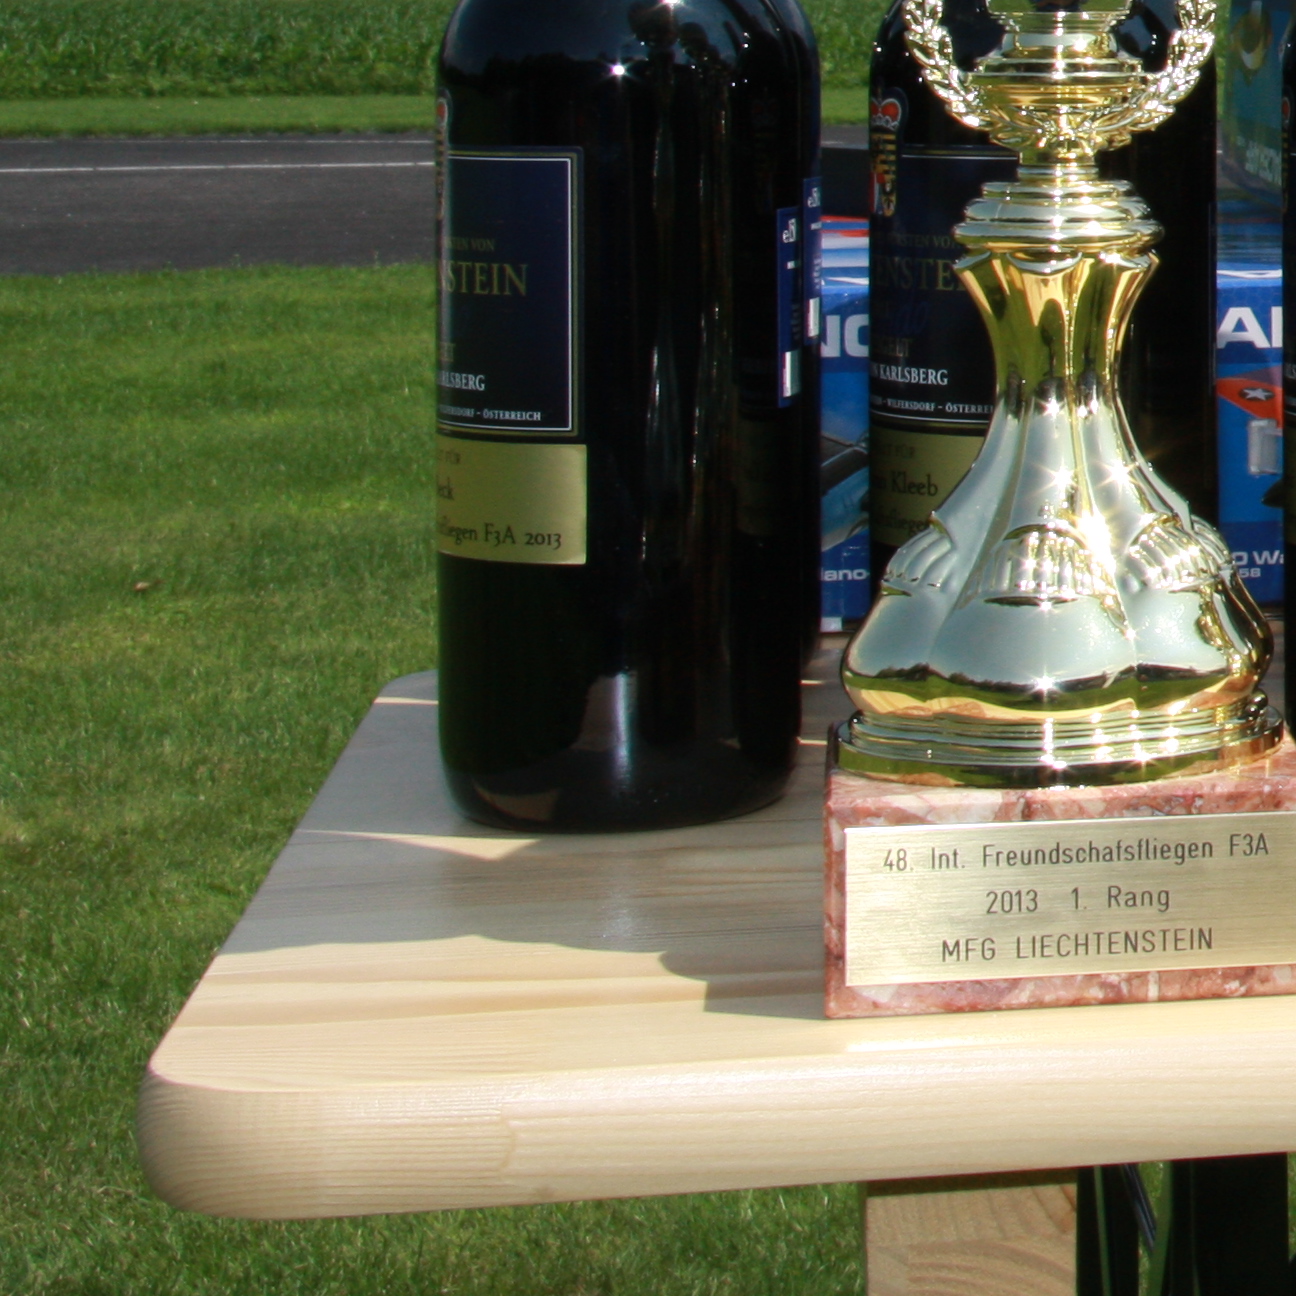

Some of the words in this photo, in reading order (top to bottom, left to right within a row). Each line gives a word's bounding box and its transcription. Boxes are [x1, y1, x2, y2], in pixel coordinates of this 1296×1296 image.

[1217, 307, 1283, 348] A
[879, 364, 949, 386] KARLSBERG
[482, 408, 541, 422] ÖSTERREICH
[892, 470, 938, 497] Kleeb
[484, 523, 516, 547] F3A
[524, 533, 562, 550] 2013
[883, 848, 914, 872] 48.
[930, 847, 965, 870] Int.
[983, 837, 1214, 868] Freundschafsfliegen
[1229, 833, 1269, 858] F3A
[986, 888, 1039, 915] 2013
[1071, 887, 1087, 911] 1.
[1107, 885, 1171, 911] Rang
[941, 937, 996, 963] MFG
[1015, 926, 1214, 960] LIECHTENSTEIN
